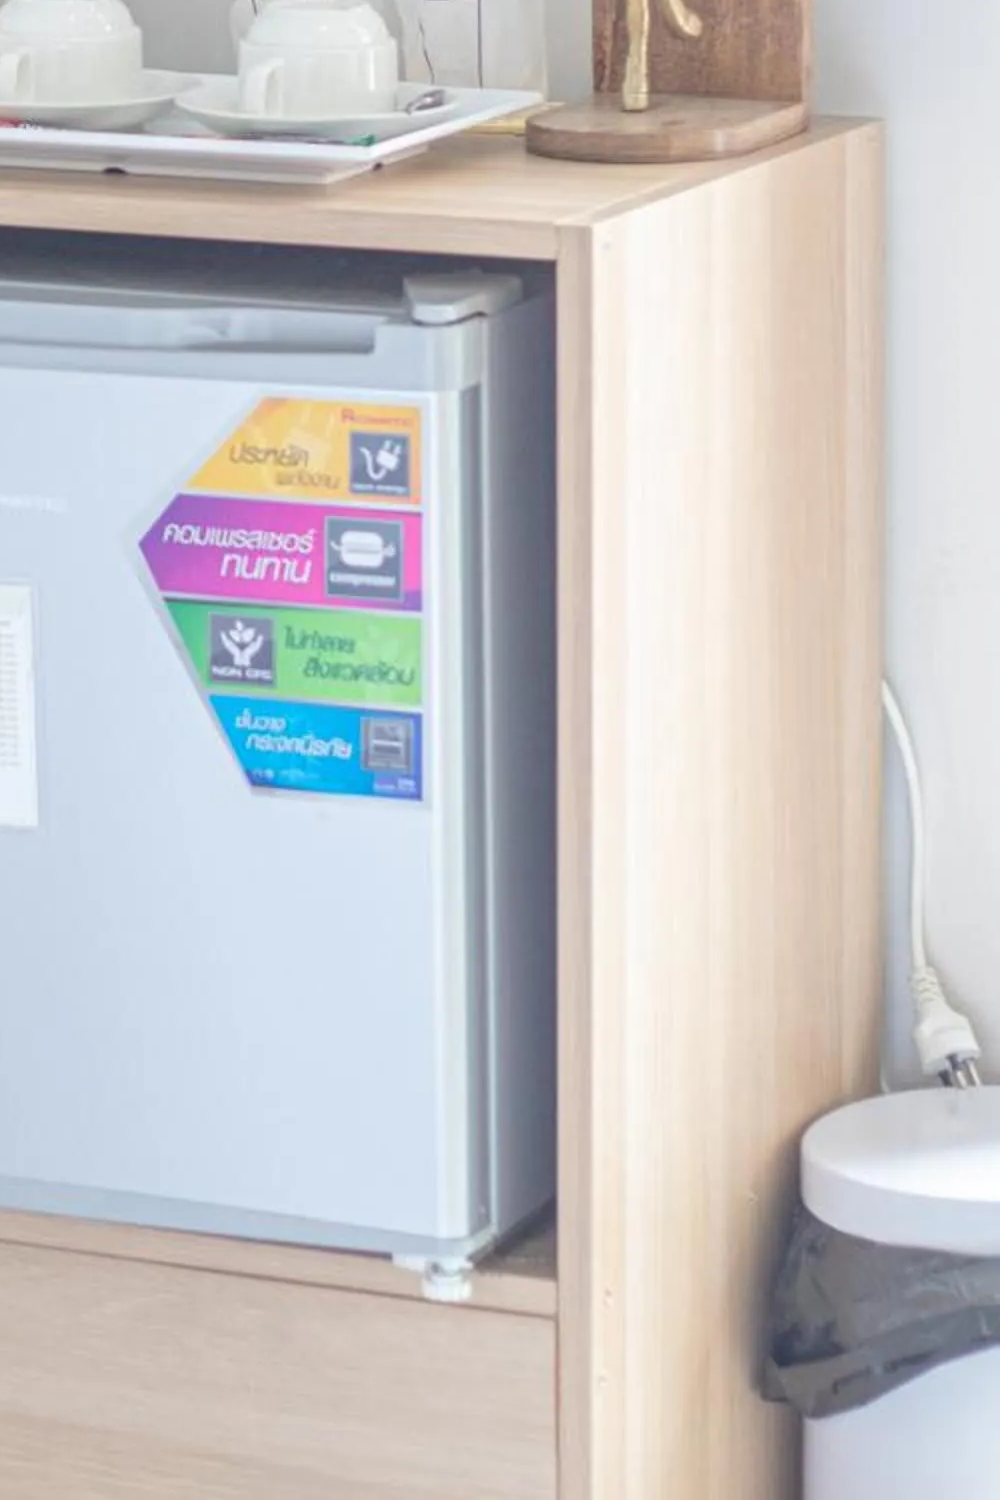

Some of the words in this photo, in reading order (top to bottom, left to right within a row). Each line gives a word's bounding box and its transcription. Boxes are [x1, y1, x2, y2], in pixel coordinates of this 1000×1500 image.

[162, 523, 317, 553] คอมเพรสเซอร์
[220, 553, 312, 584] ทนทาน
